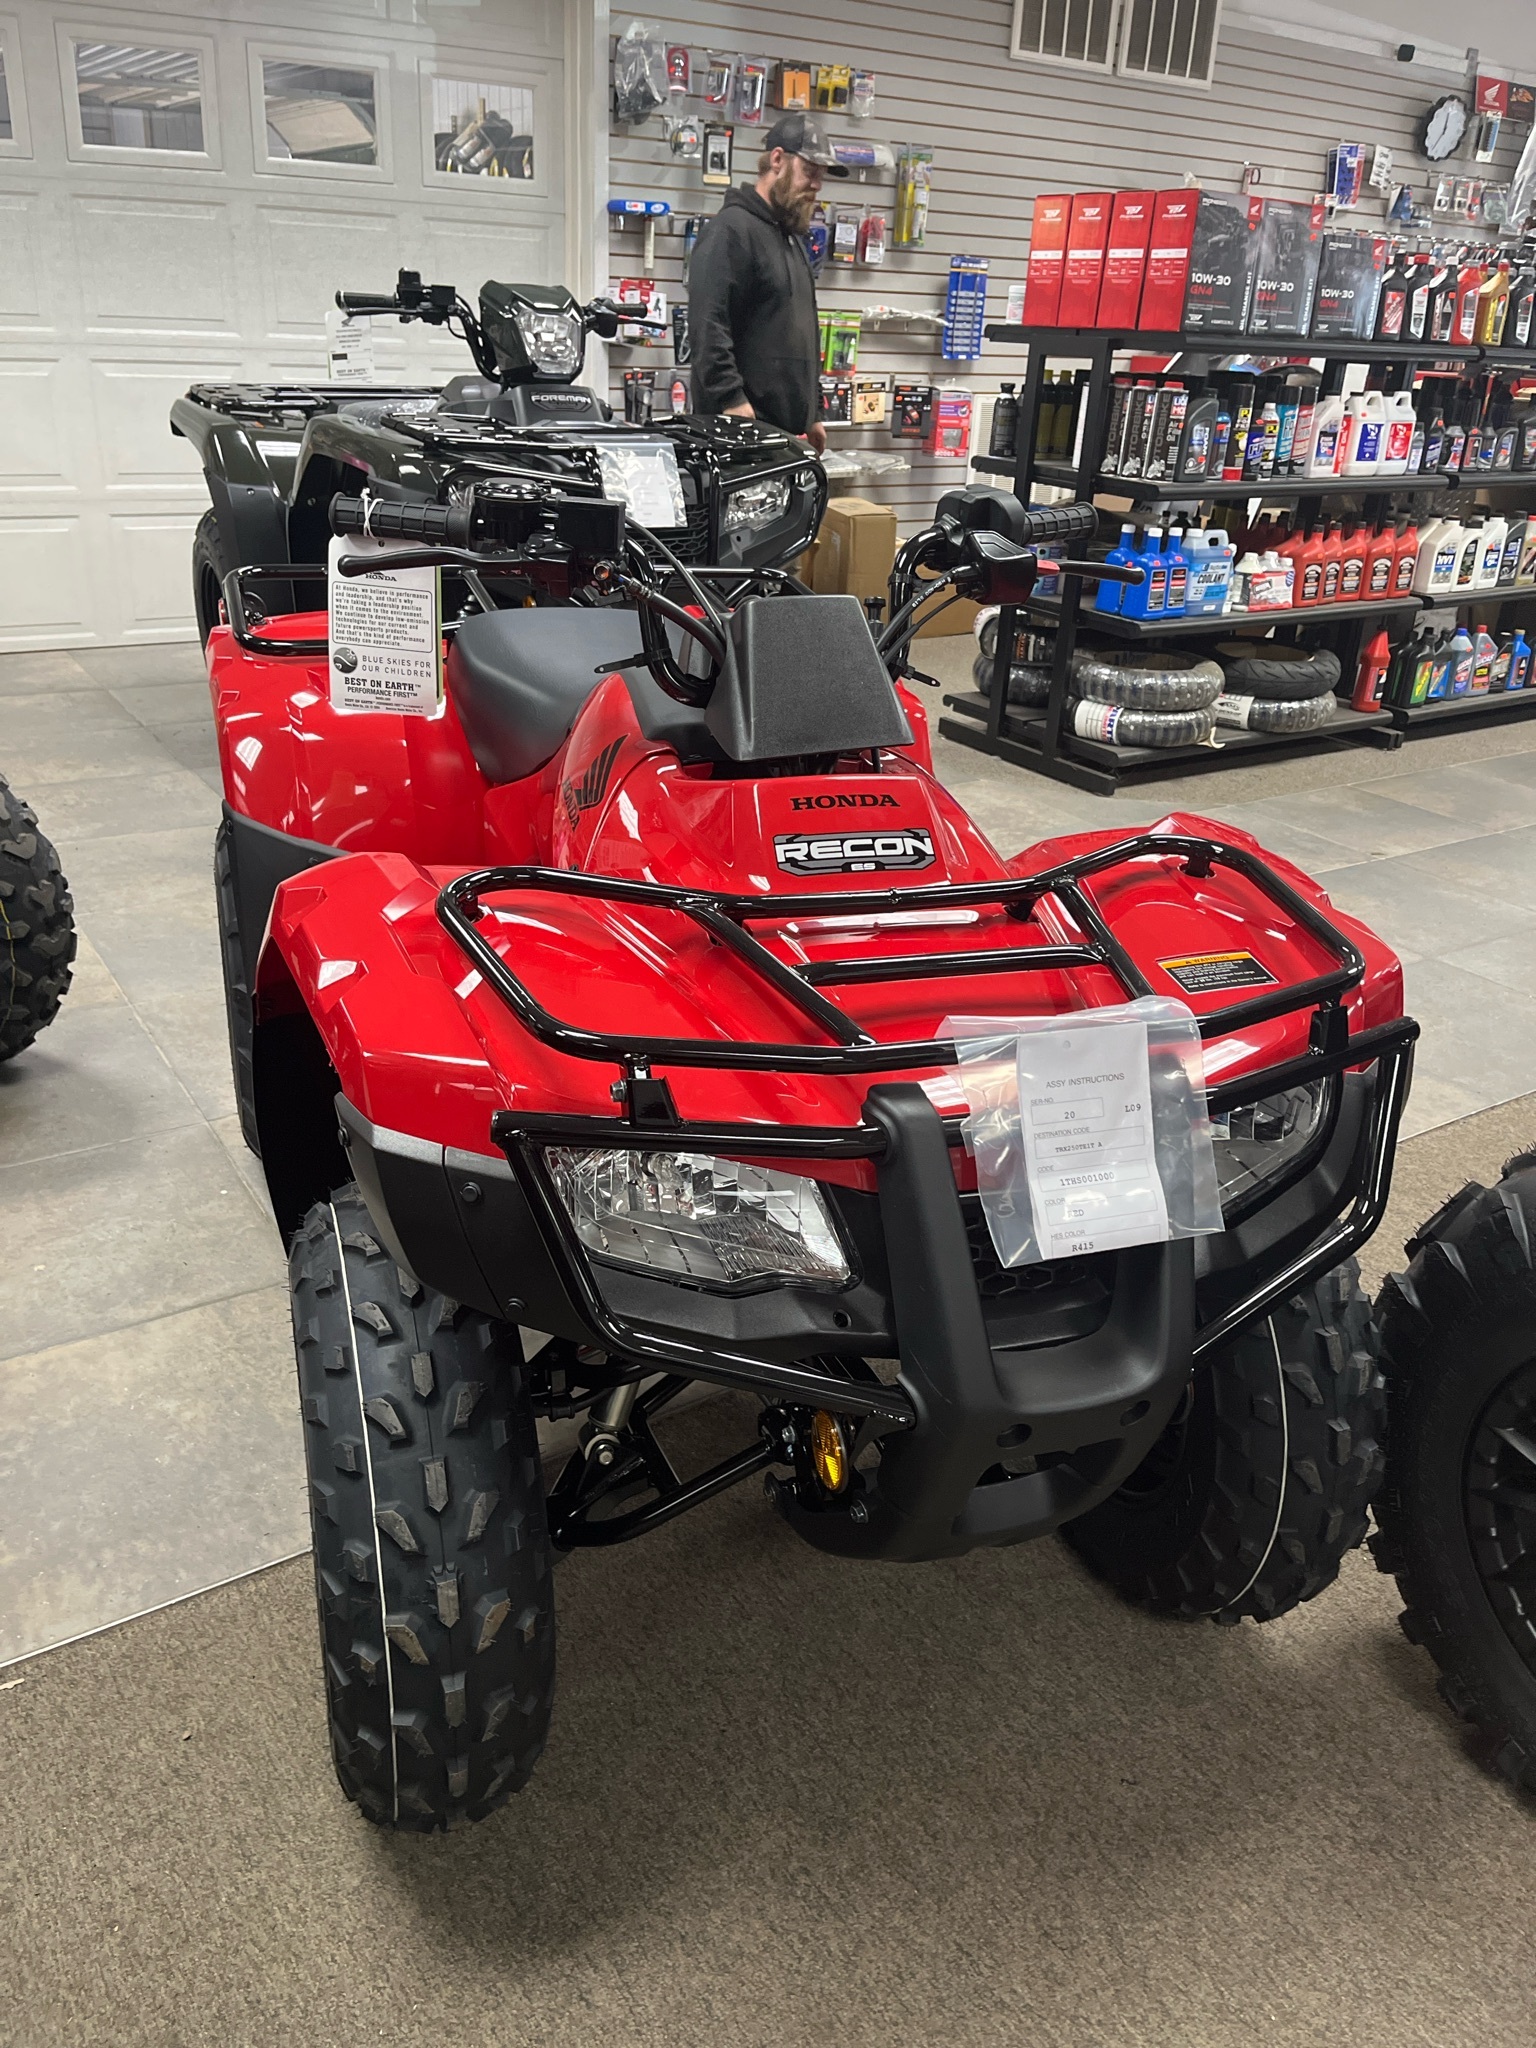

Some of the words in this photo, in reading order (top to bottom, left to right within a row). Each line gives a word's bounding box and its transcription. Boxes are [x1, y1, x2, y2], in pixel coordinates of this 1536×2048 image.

[1191, 273, 1231, 286] 10W-30
[1190, 285, 1213, 295] GN4
[1257, 280, 1294, 292] 10W-30
[1321, 288, 1354, 299] 10W-30
[1241, 285, 1250, 316] CHANGE
[1303, 292, 1312, 321] CHANGE
[531, 395, 591, 403] FOREMAN
[1197, 573, 1225, 584] COOLANT
[373, 601, 399, 610] leadership
[396, 616, 429, 624] low-emission
[393, 635, 425, 643] performance
[362, 655, 383, 664] BLUE
[387, 658, 411, 666] SKIES
[385, 667, 432, 678] CHILDREN
[344, 677, 367, 686] BEST
[370, 680, 382, 688] ON
[347, 686, 391, 696] PERFORMANCE
[562, 776, 580, 832] HONDA
[790, 794, 900, 811] HONDA
[775, 837, 934, 863] RECON
[850, 862, 876, 871] ES
[1046, 1079, 1066, 1088] ASSY
[1068, 1073, 1125, 1086] INSTRUCTIONS
[1125, 1104, 1141, 1113] L09
[1064, 1111, 1075, 1119] 20
[1034, 1129, 1072, 1139] DESTINATION
[1073, 1127, 1090, 1135] CODE
[1060, 1172, 1115, 1187] 1THS001000
[1045, 1198, 1066, 1206] COLOR
[1050, 1231, 1064, 1239] HES
[1064, 1230, 1085, 1238] COLOR
[1072, 1242, 1094, 1252] R415
